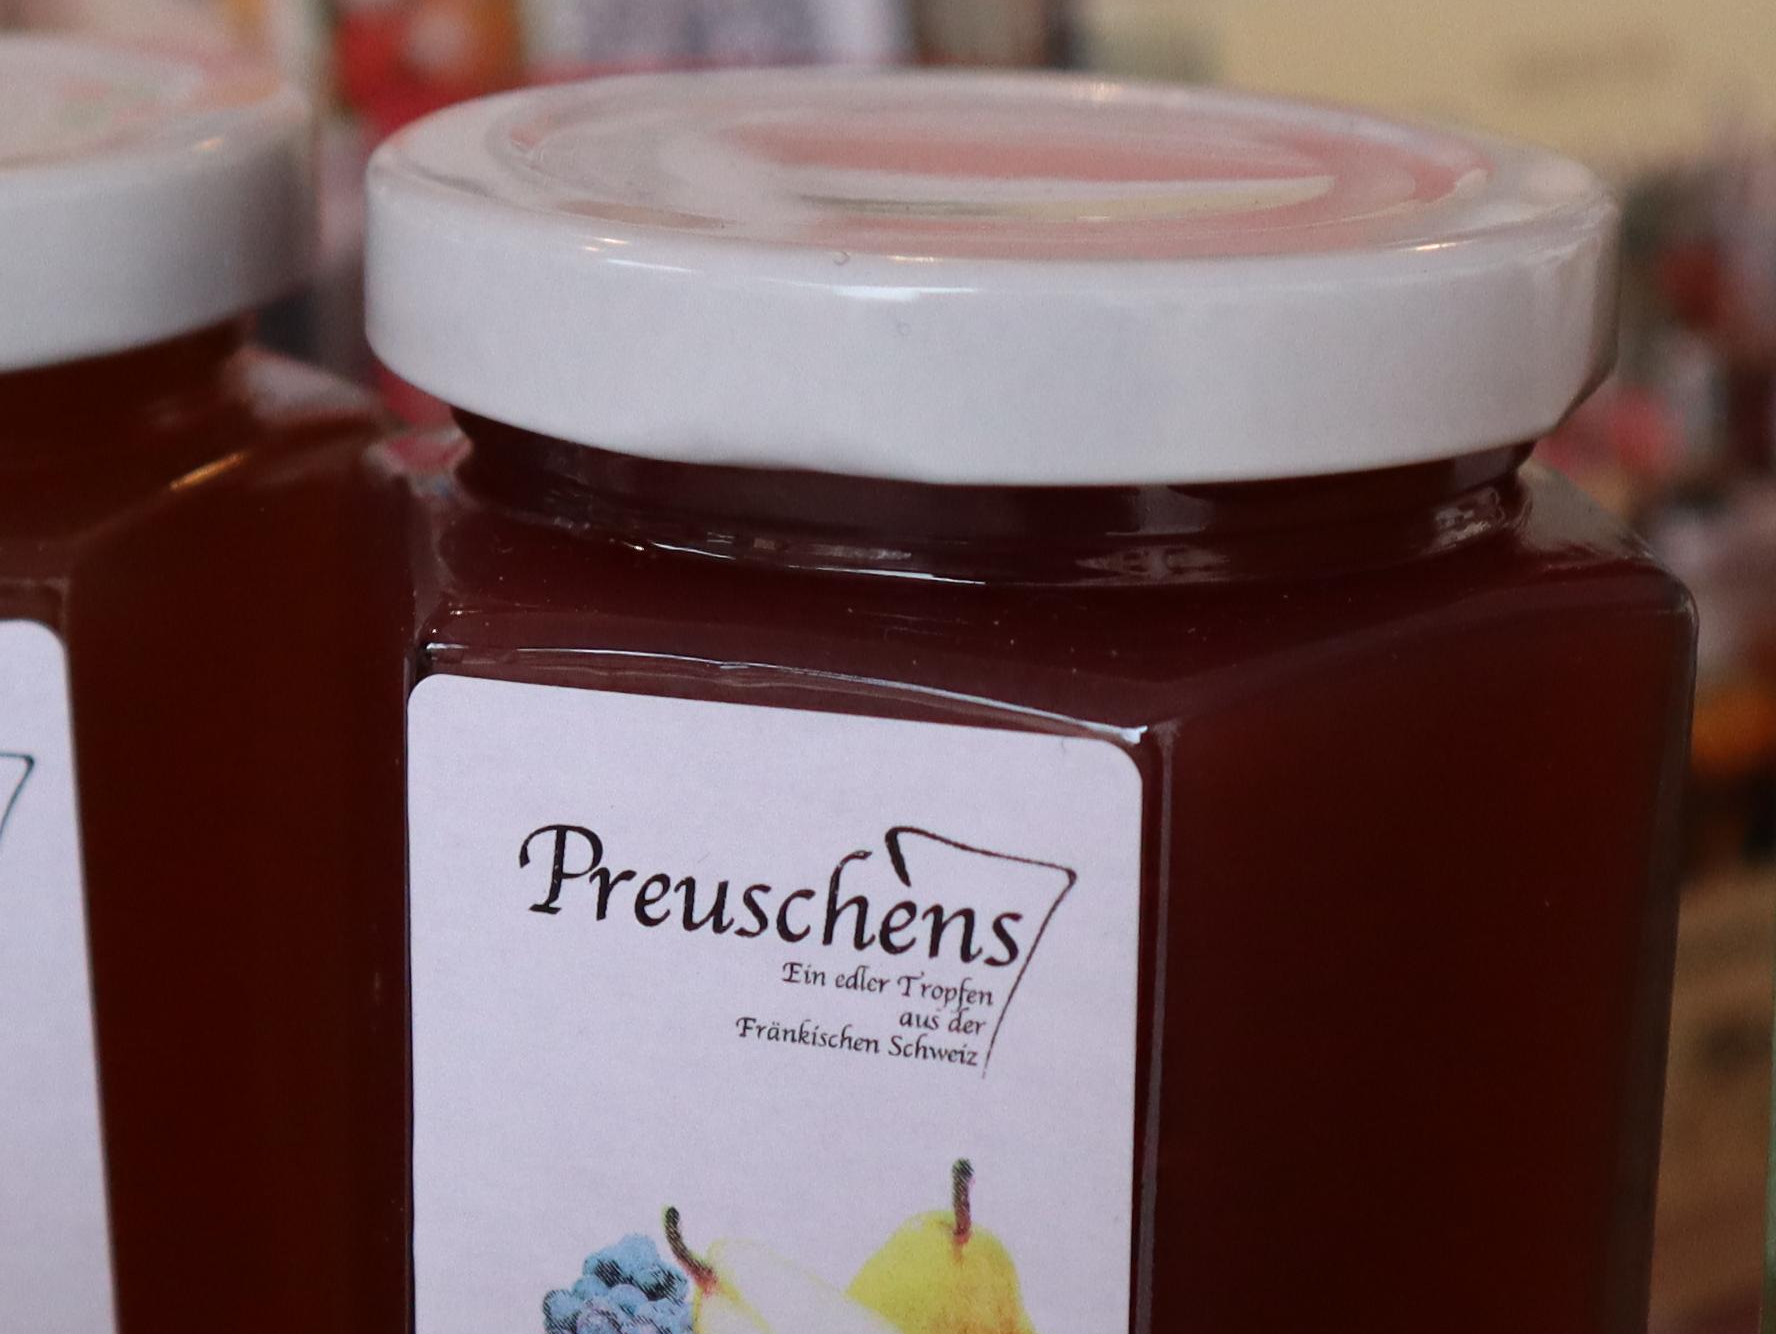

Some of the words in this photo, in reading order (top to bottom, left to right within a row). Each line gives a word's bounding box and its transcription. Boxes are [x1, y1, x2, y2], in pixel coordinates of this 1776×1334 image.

[519, 823, 1024, 968] Preuschens
[782, 962, 826, 986] Ein
[835, 965, 890, 993] edler
[897, 971, 993, 1012] Tropfen
[735, 1017, 880, 1054] Fränkischen
[888, 1033, 978, 1067] Schweiz
[899, 1011, 939, 1031] aus
[948, 1008, 987, 1035] der
